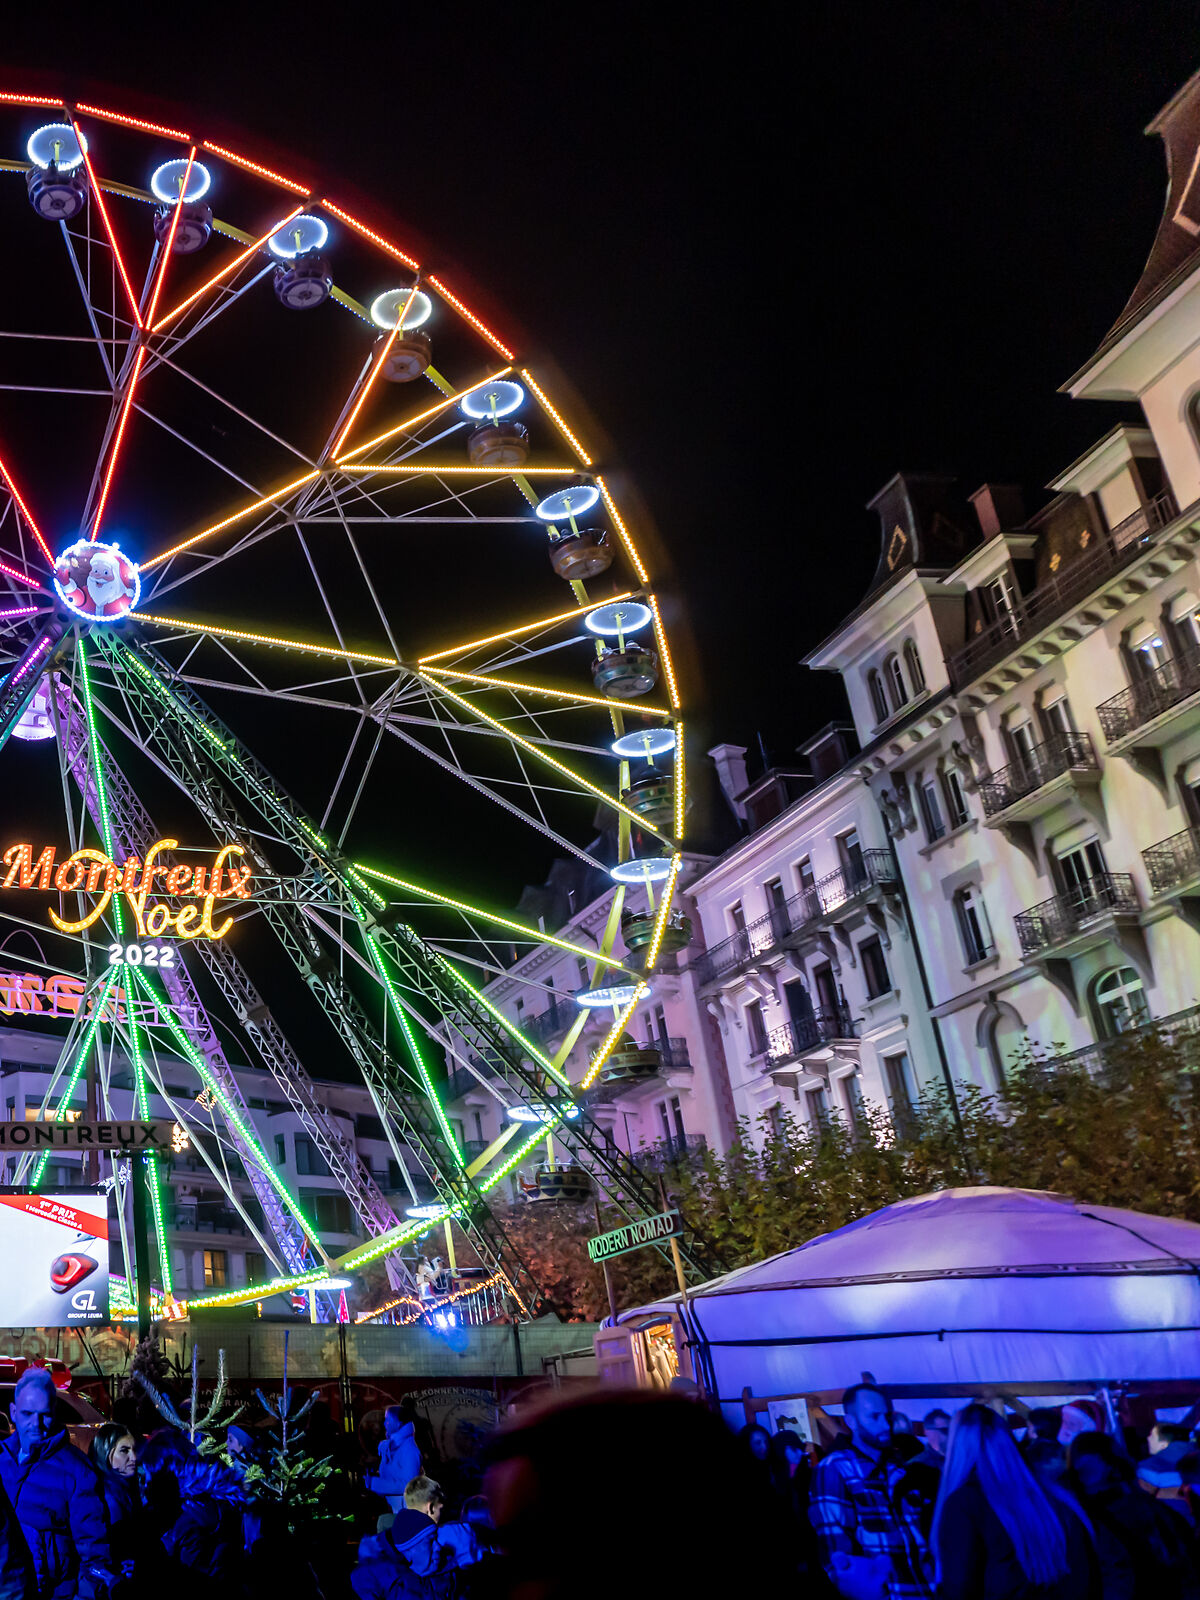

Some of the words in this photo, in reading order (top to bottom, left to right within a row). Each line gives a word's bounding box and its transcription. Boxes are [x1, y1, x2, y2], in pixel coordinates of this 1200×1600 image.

[2, 843, 253, 899] Montreux
[108, 943, 176, 968] 2022
[51, 1205, 77, 1220] PRIX
[587, 1229, 630, 1260] MODERN
[630, 1215, 674, 1244] NOMAD
[71, 1290, 97, 1310] GL
